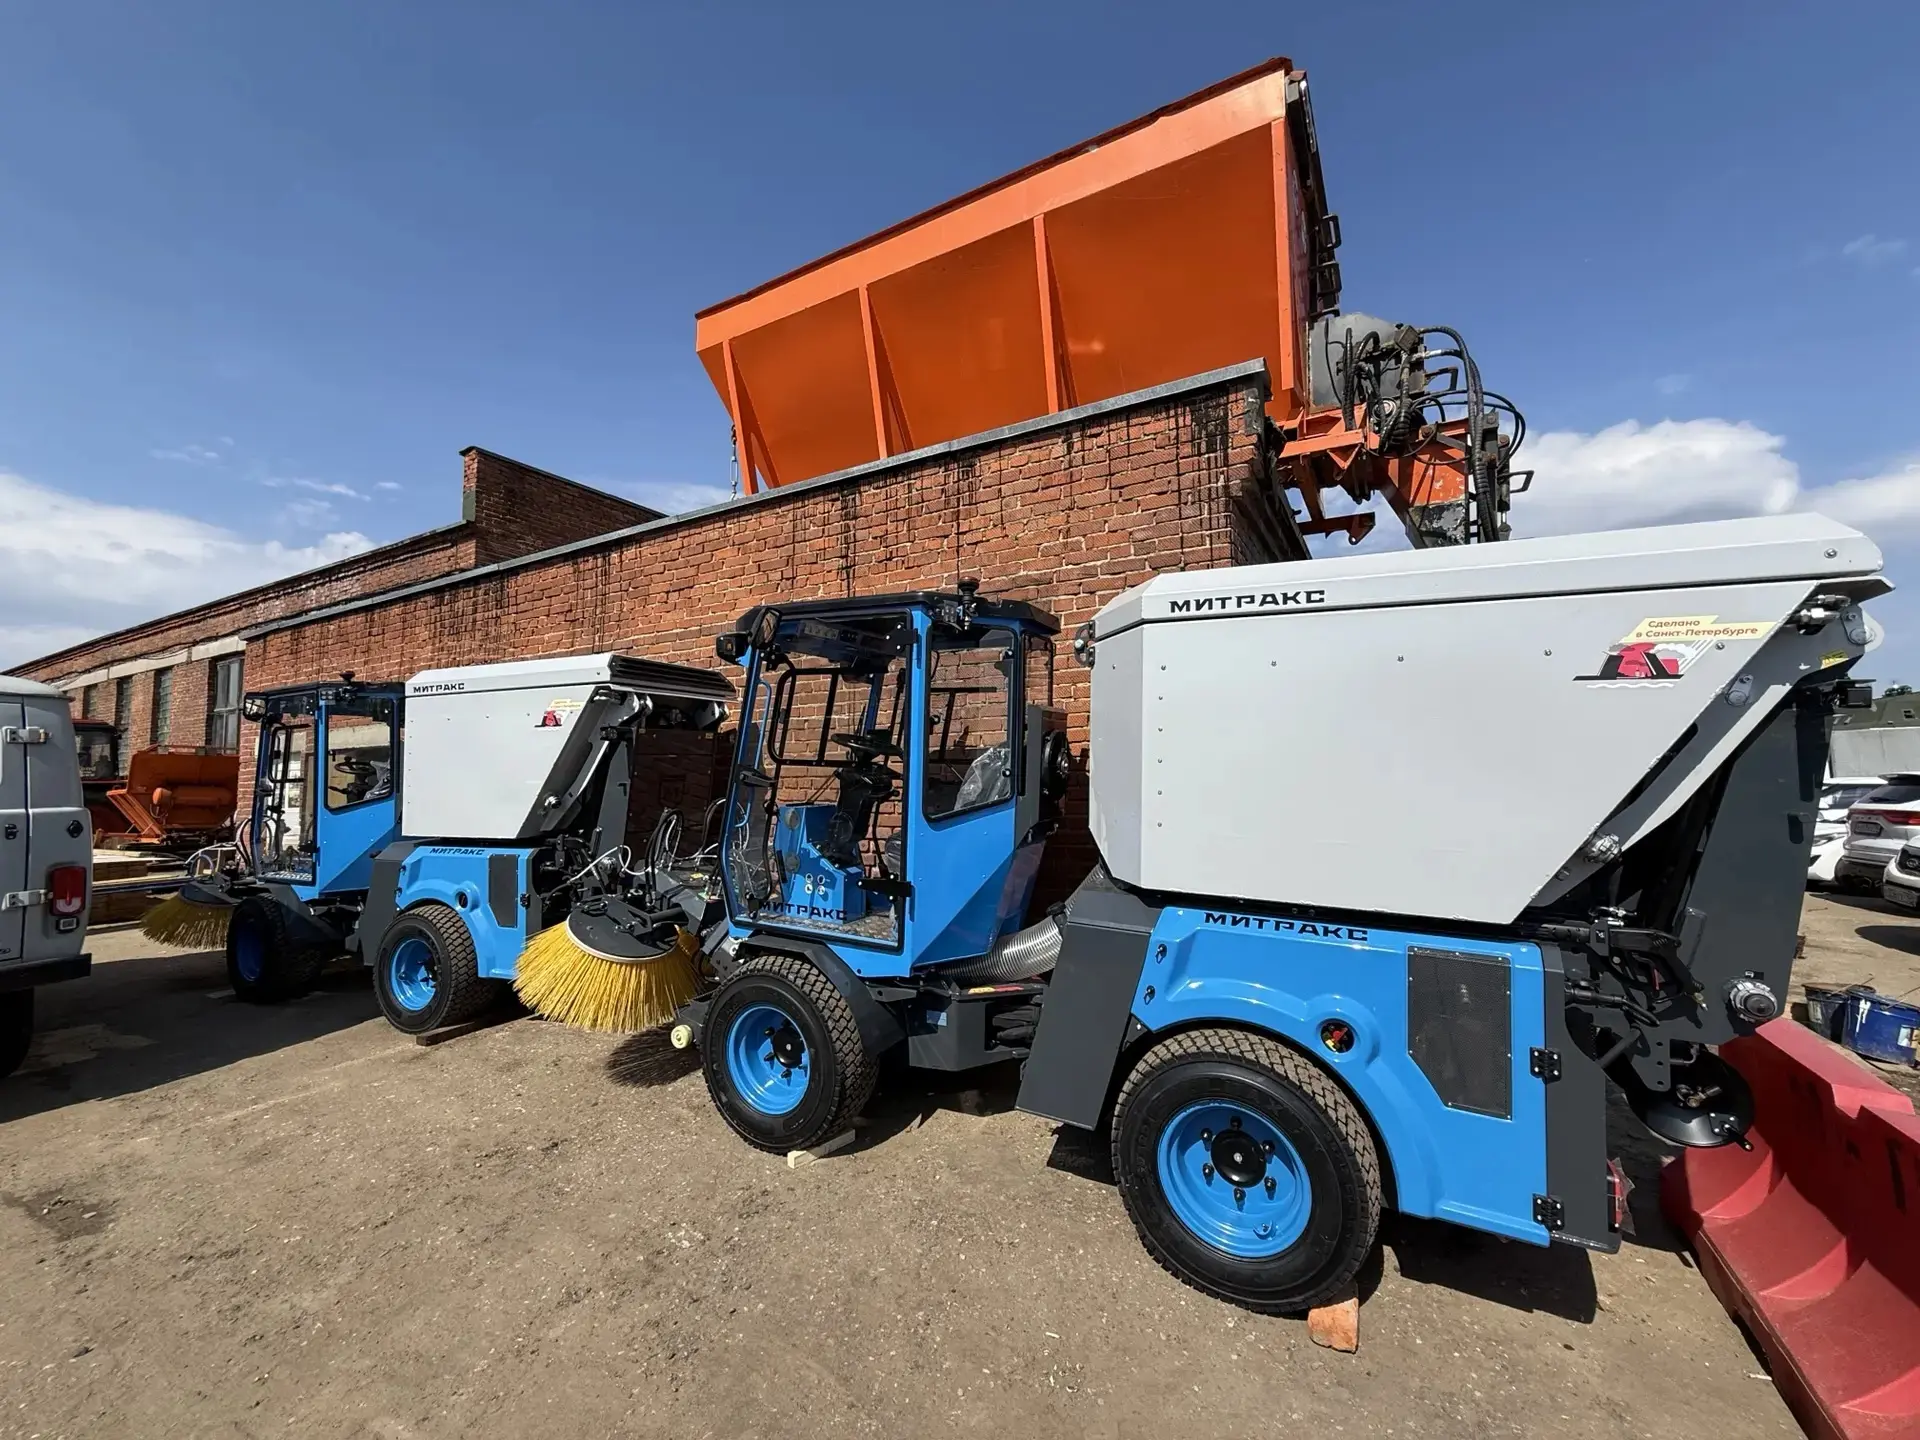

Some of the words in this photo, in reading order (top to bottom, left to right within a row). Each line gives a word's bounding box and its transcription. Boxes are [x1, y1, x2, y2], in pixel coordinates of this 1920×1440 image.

[1168, 589, 1325, 613] МИТРАКС
[1648, 620, 1701, 628] Сделано
[1645, 627, 1759, 638] Санкт-Петербурге
[413, 682, 465, 694] МИТРАКС
[429, 847, 486, 856] МИТРАКС
[1204, 911, 1368, 942] МИТРАКС
